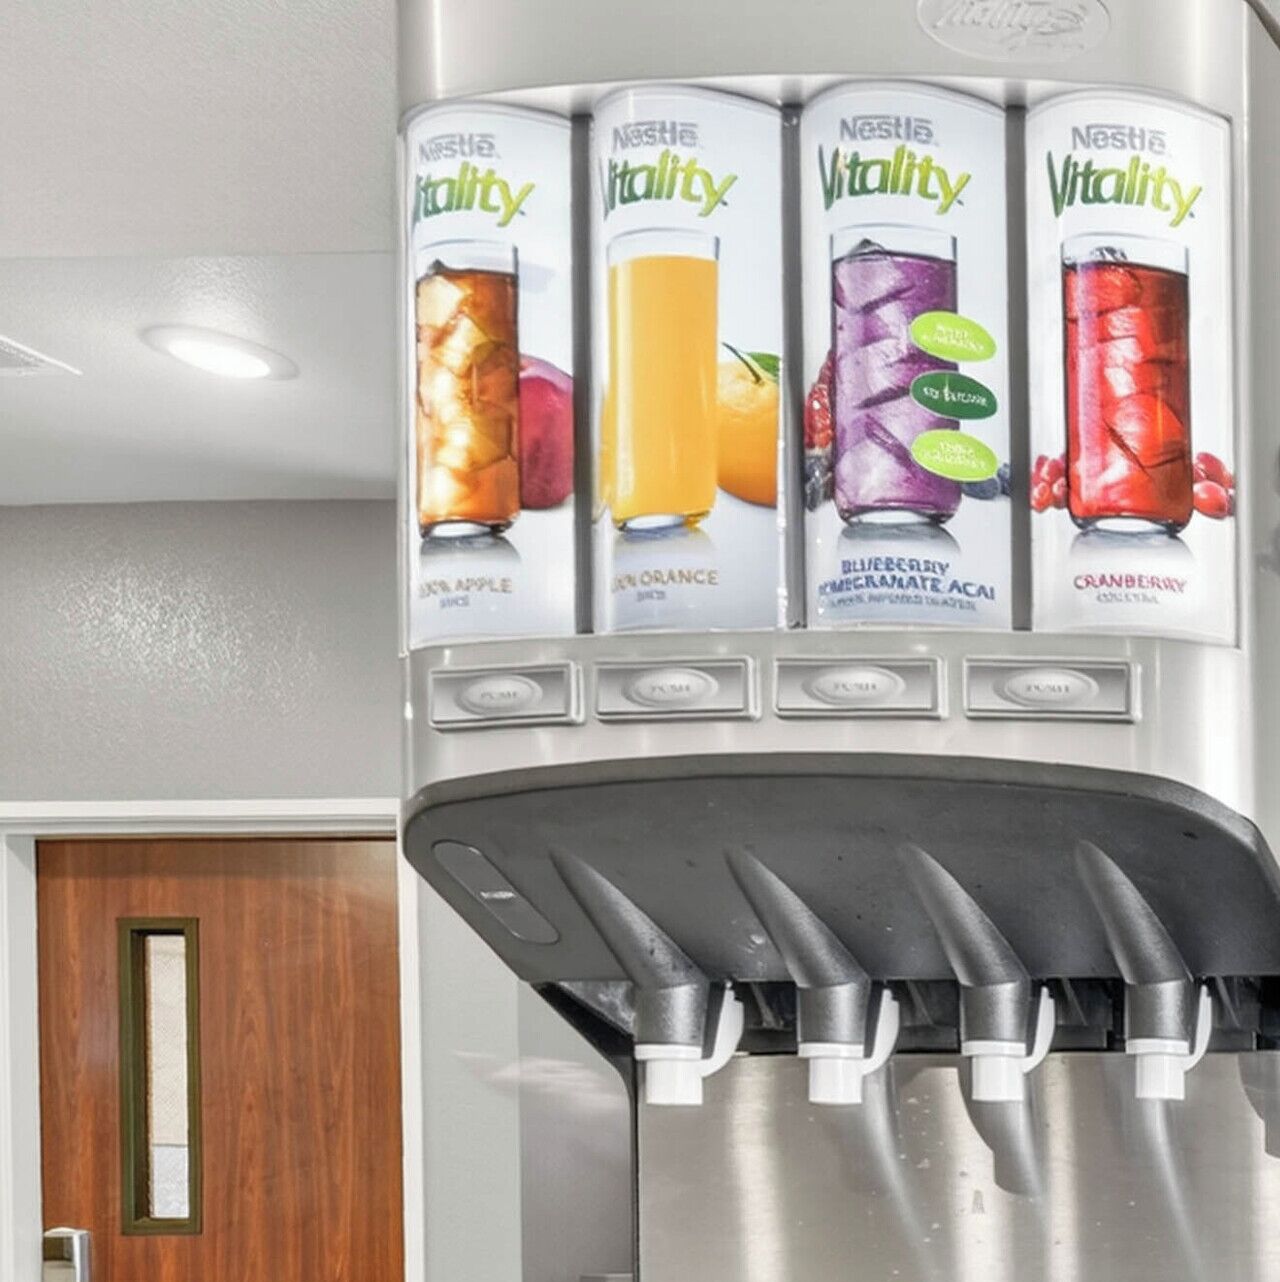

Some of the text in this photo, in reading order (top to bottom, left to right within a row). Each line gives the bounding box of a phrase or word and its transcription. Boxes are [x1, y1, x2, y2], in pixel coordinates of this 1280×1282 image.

[818, 144, 971, 215] Vitality
[1047, 151, 1202, 227] Vitality
[841, 557, 950, 576] BLUEBERRY
[455, 577, 513, 594] APPLE
[640, 569, 719, 586] ORANGE
[1073, 574, 1187, 593] CRANBERRY
[948, 579, 996, 601] ACAI
